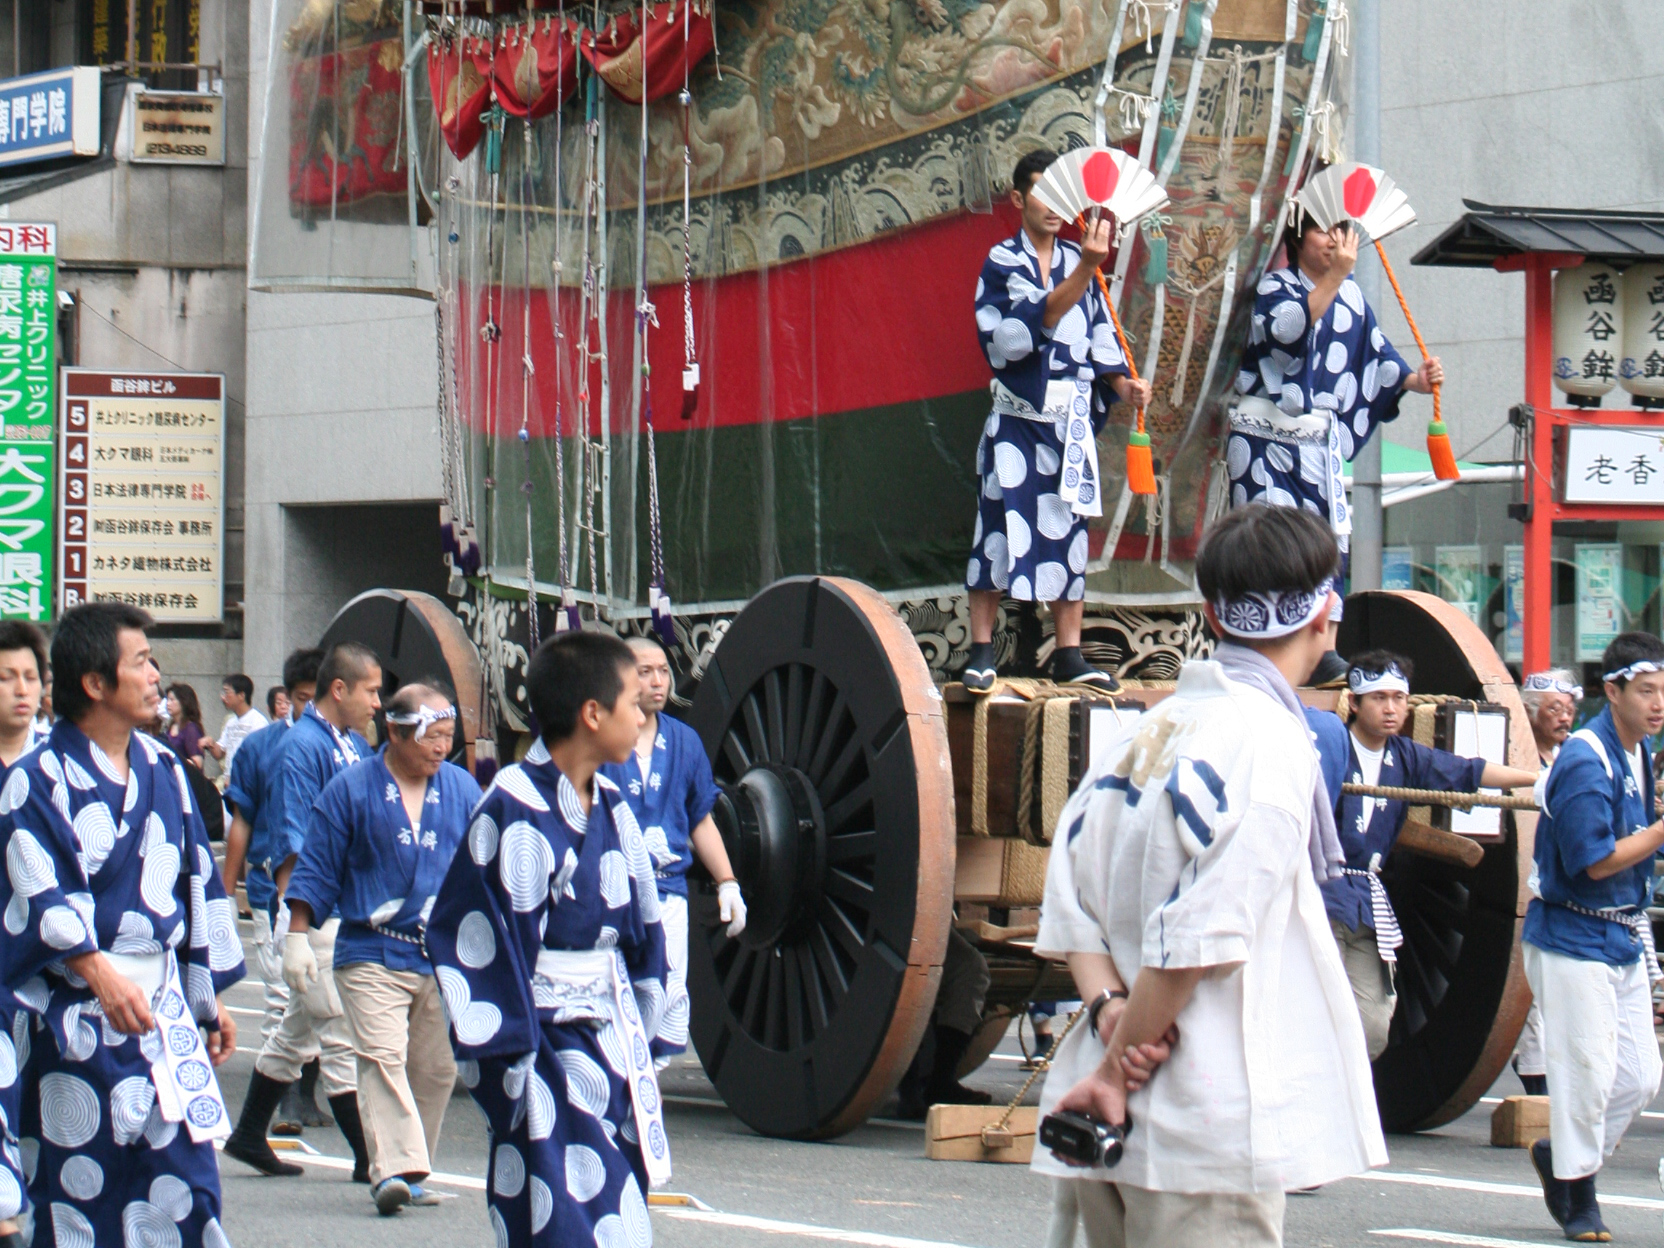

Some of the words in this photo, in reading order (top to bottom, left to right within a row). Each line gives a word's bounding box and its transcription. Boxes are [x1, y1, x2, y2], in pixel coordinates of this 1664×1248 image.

[1582, 273, 1617, 383] 函谷鉾
[26, 288, 49, 420] 井上クリニック
[110, 378, 177, 394] 函谷鉾ビル
[70, 406, 86, 426] 5
[69, 443, 85, 463] 4
[94, 446, 154, 463] 大クマ眼科
[69, 479, 85, 499] 3
[93, 483, 187, 500] 日本法律専門学院
[69, 515, 84, 535] 2
[70, 552, 81, 572] 1
